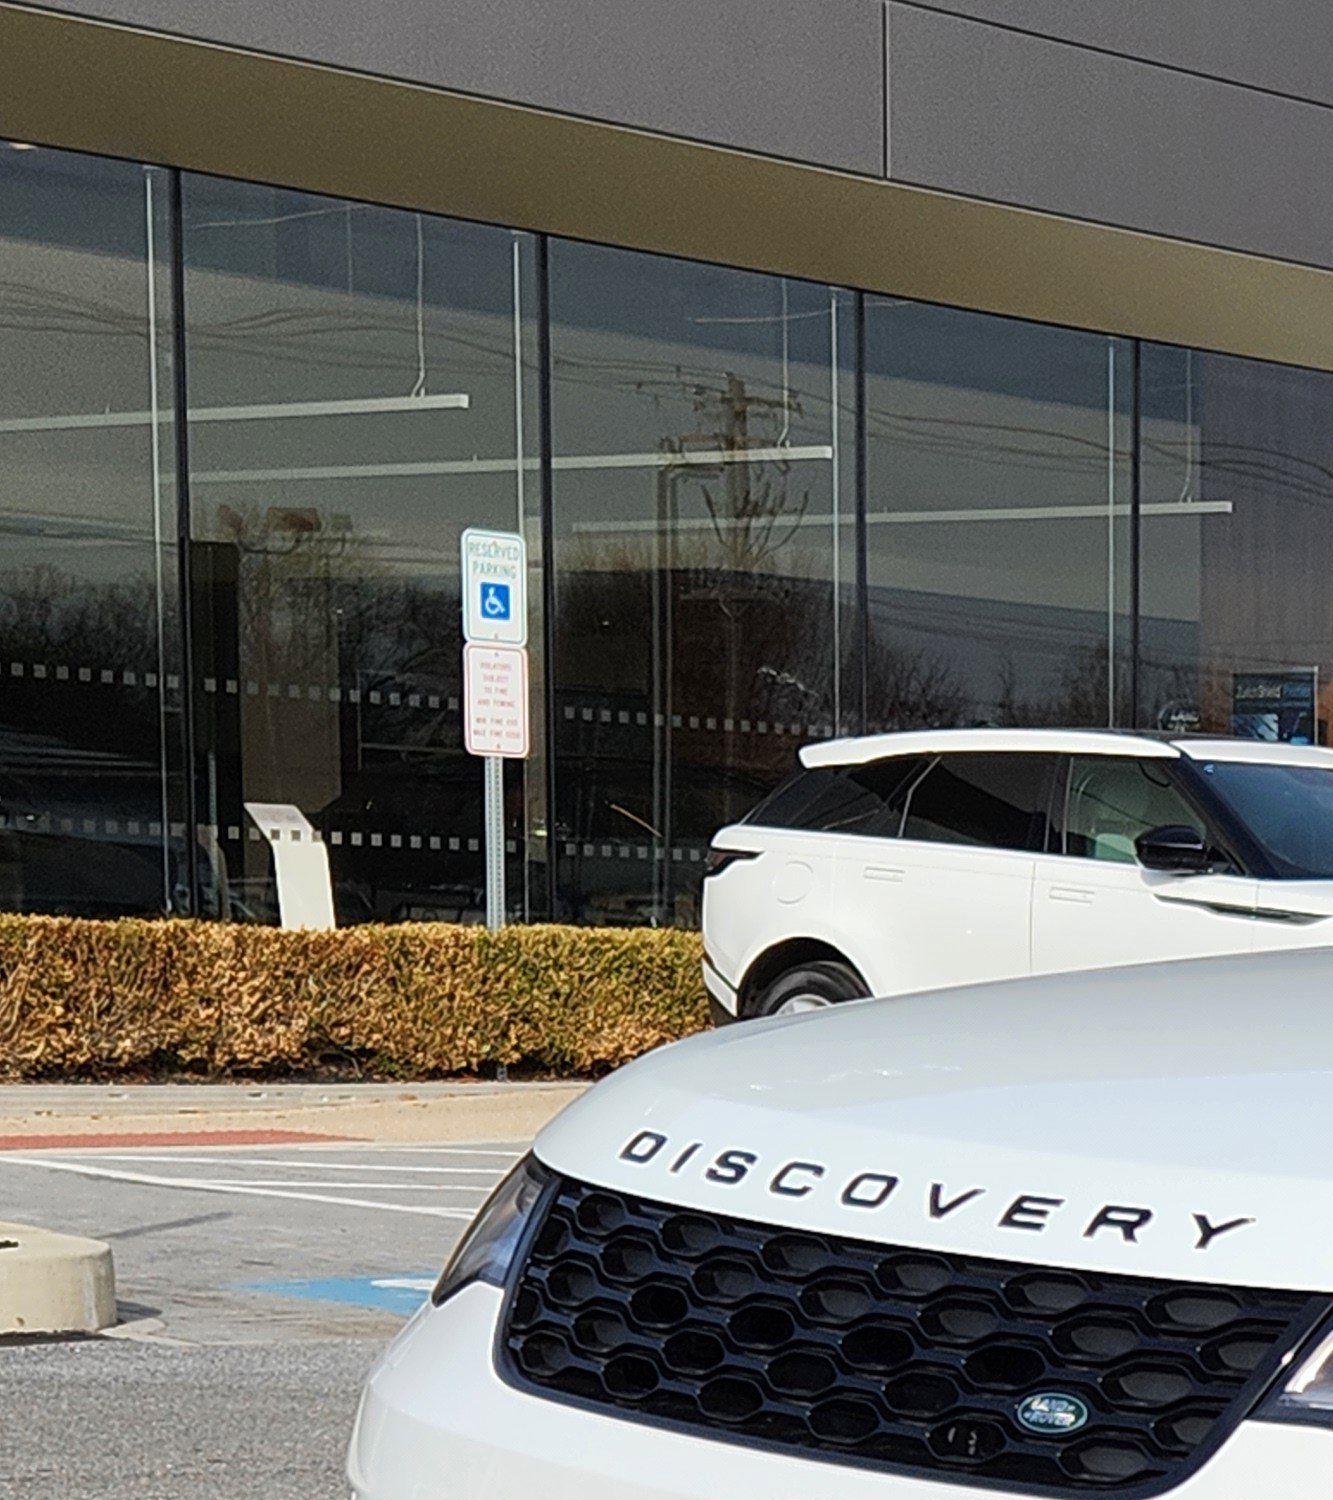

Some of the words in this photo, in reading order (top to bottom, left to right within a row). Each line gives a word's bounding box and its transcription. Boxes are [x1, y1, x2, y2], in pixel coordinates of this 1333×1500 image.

[468, 541, 519, 561] RESERVED
[472, 560, 516, 580] PARKING
[619, 1129, 1257, 1250] DISCOVERY
[1030, 1399, 1071, 1412] LAND
[1028, 1411, 1076, 1428] ROVER
